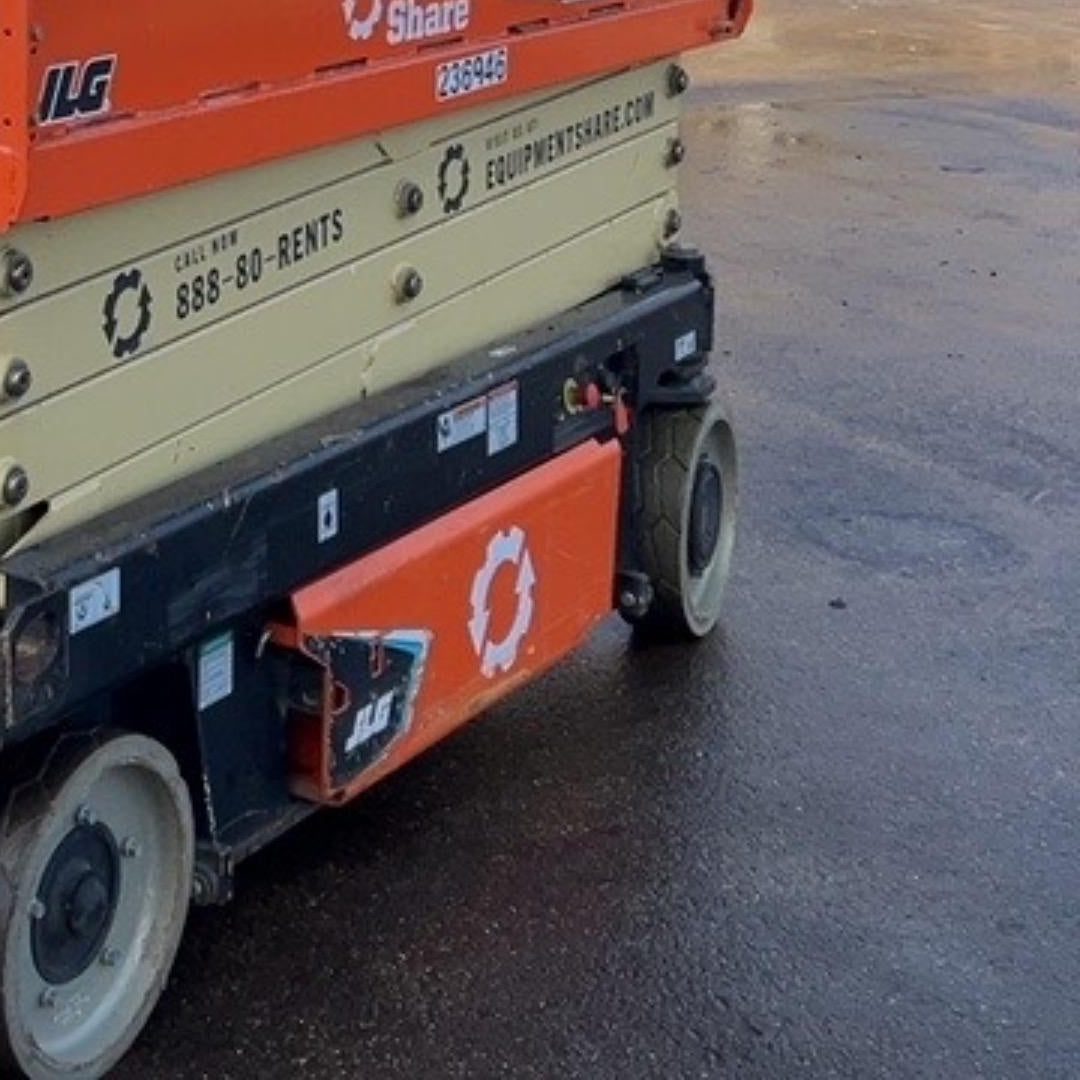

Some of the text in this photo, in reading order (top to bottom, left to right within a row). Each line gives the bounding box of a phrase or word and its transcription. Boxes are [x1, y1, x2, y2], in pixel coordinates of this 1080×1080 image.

[438, 49, 505, 98] 236946
[485, 90, 656, 190] EQUIPMENTSHARE.COM
[175, 208, 344, 320] 888-80-RENTS
